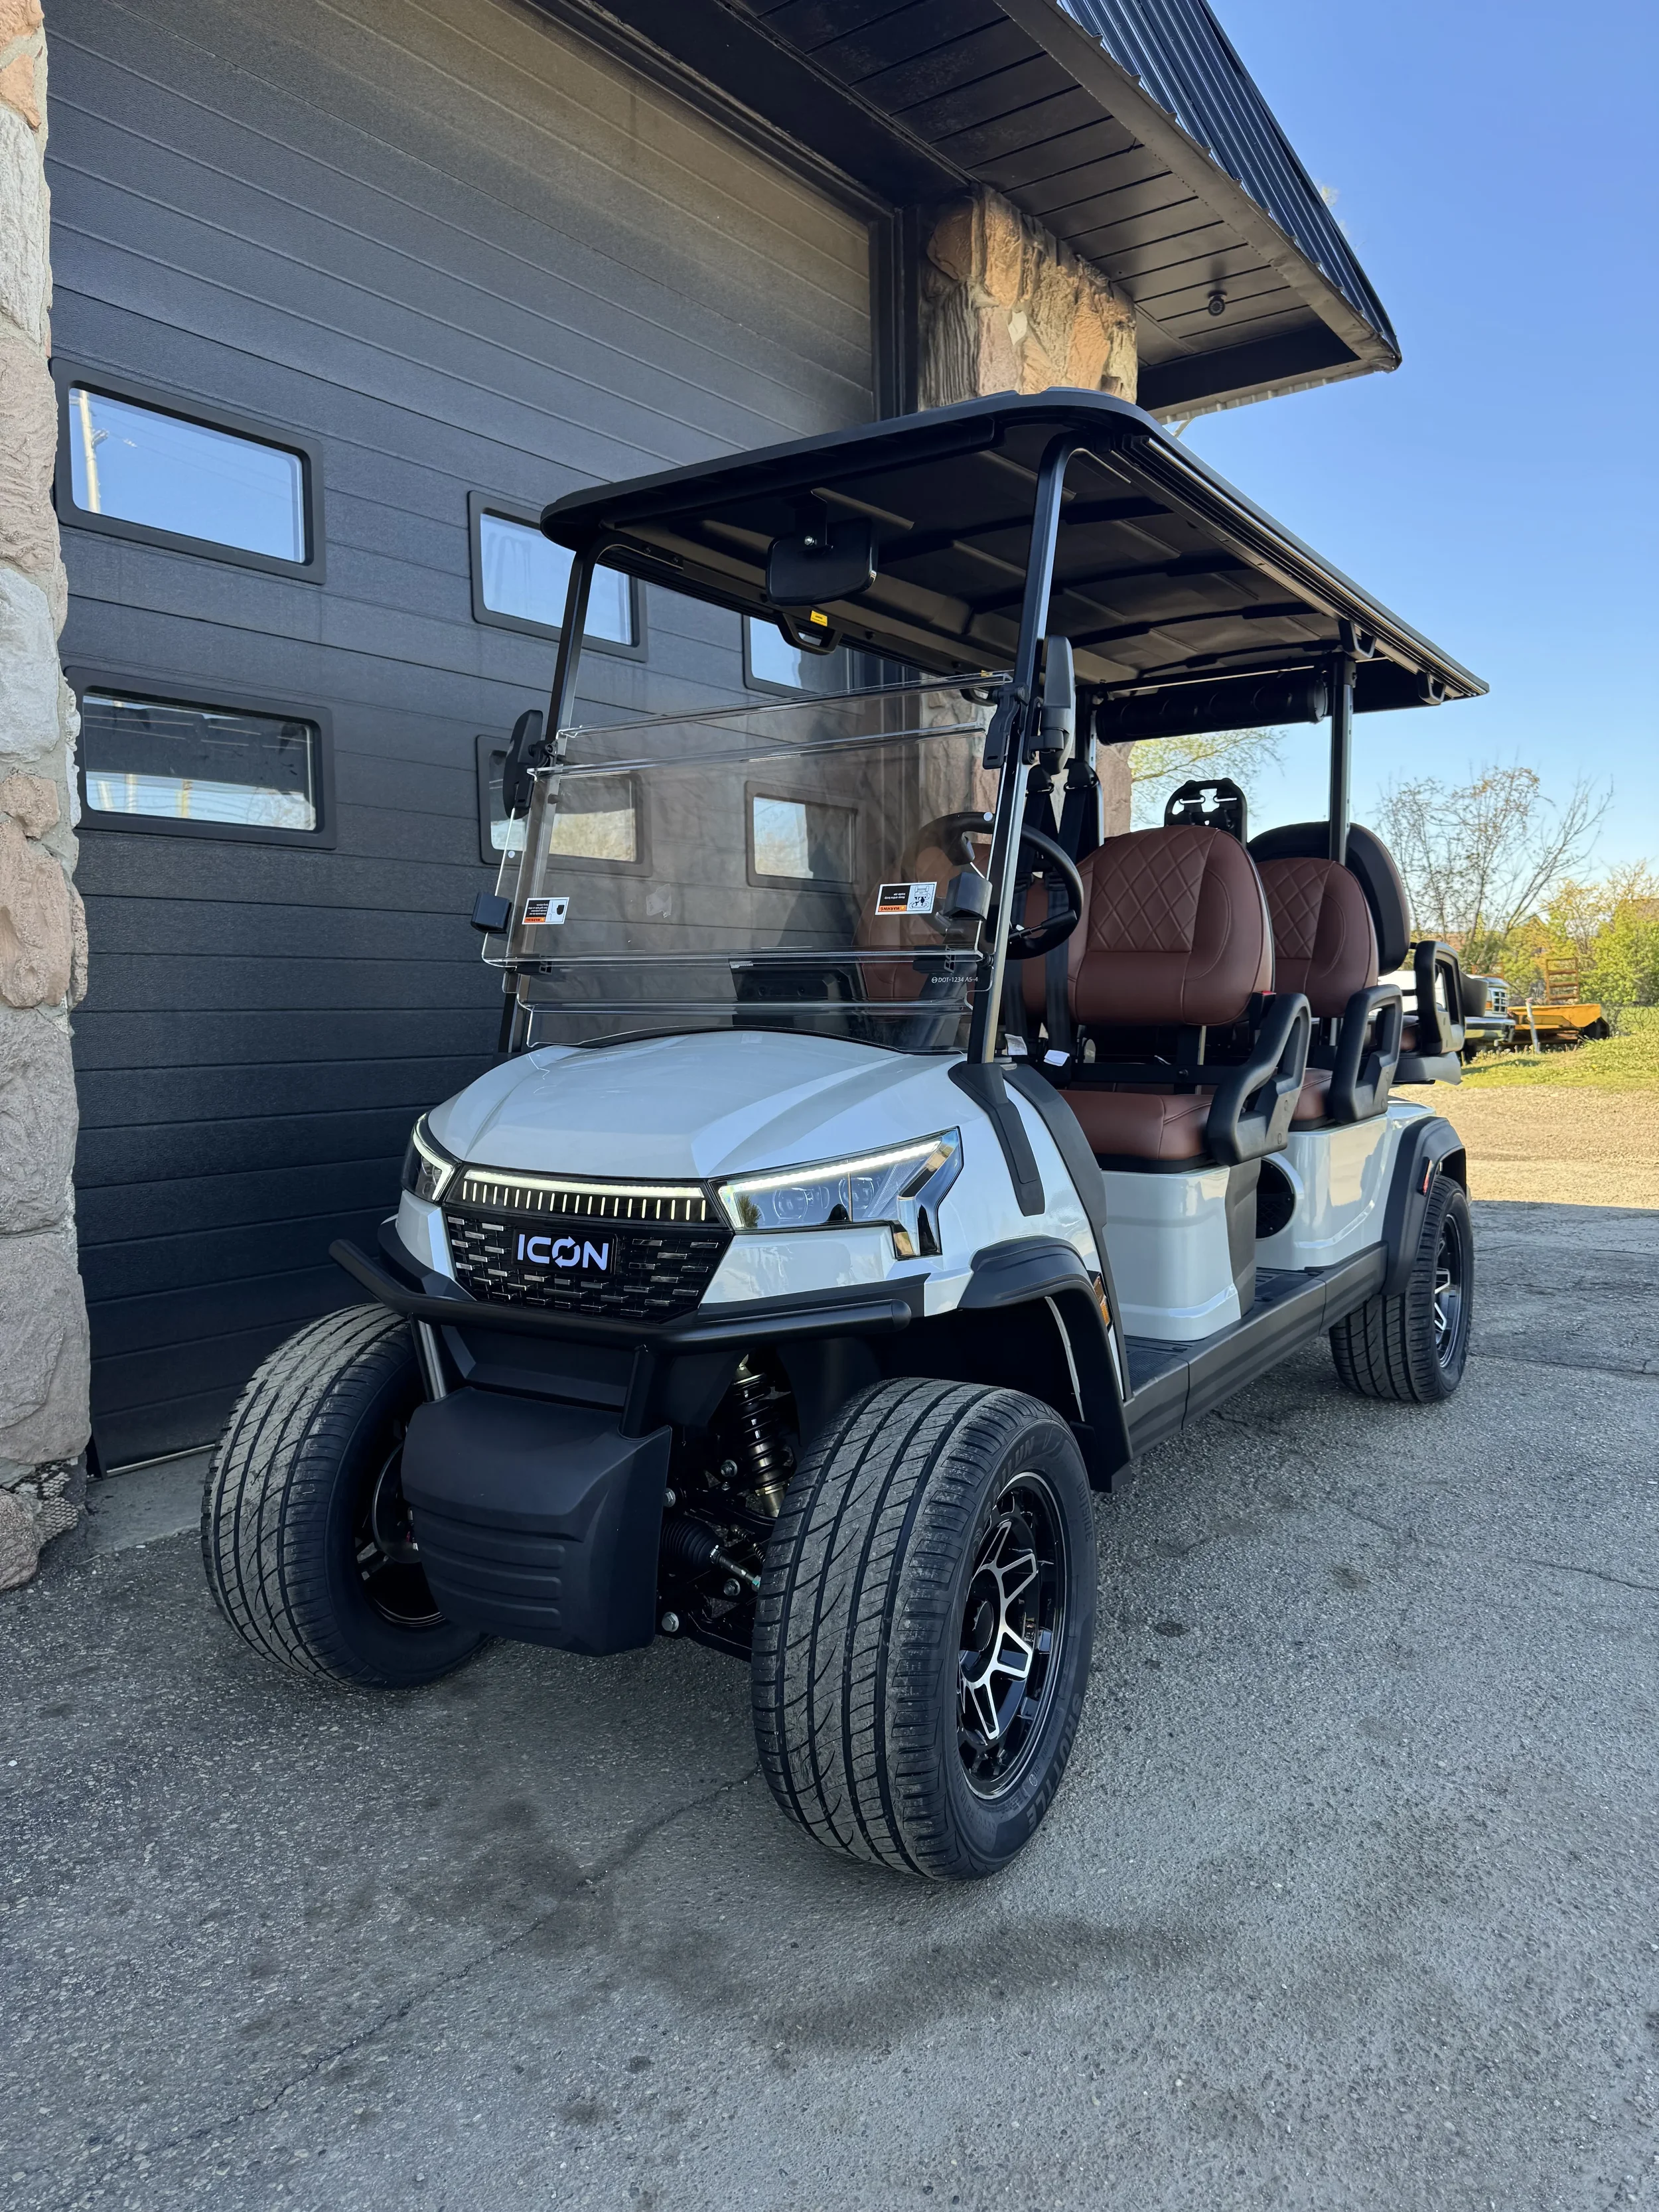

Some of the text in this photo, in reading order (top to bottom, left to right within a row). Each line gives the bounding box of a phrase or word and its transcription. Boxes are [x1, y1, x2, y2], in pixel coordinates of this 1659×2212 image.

[517, 1233, 609, 1271] ICON
[1076, 1480, 1094, 1542] OUTSIDE
[1026, 1692, 1082, 1834] SHUTTLE
